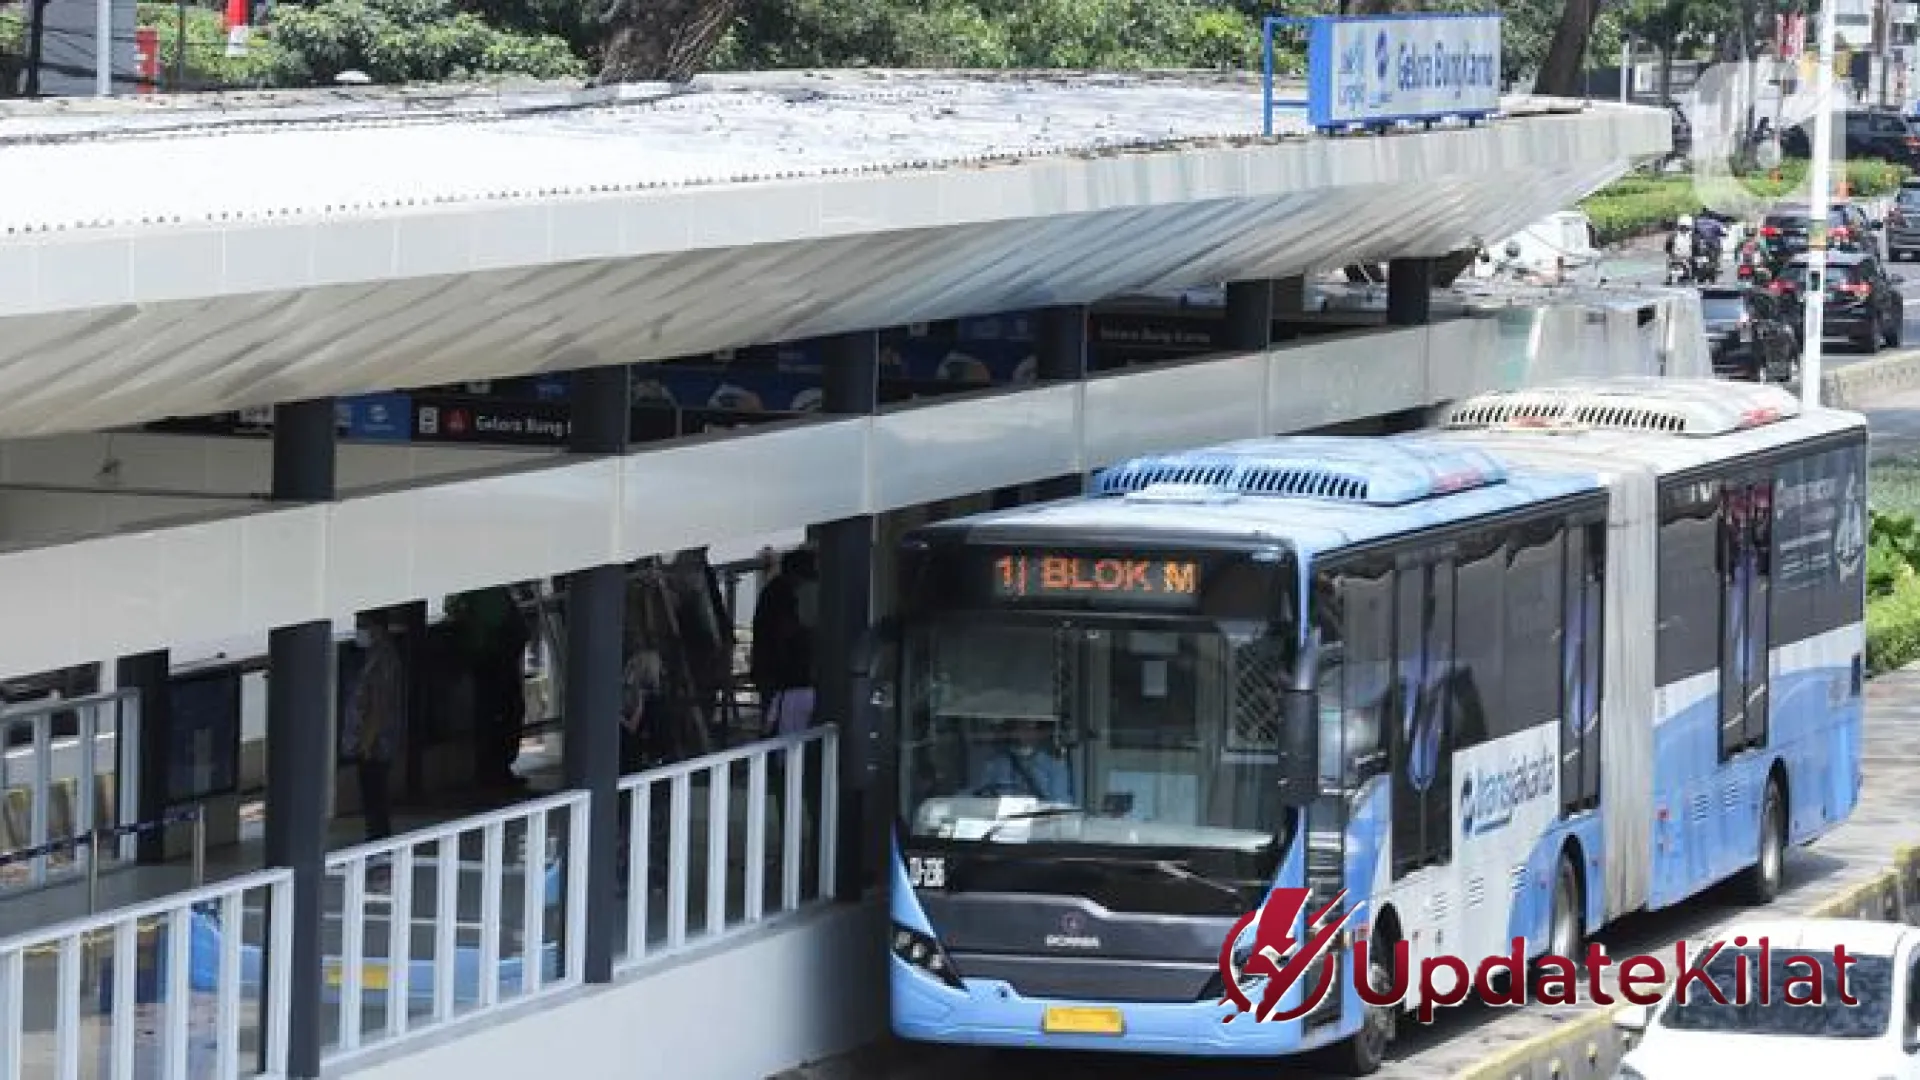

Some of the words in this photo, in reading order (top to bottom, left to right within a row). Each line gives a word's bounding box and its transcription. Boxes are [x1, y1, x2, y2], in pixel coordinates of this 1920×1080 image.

[1398, 41, 1432, 92] Gelora
[1041, 557, 1152, 591] BLOK
[1163, 561, 1196, 593] M
